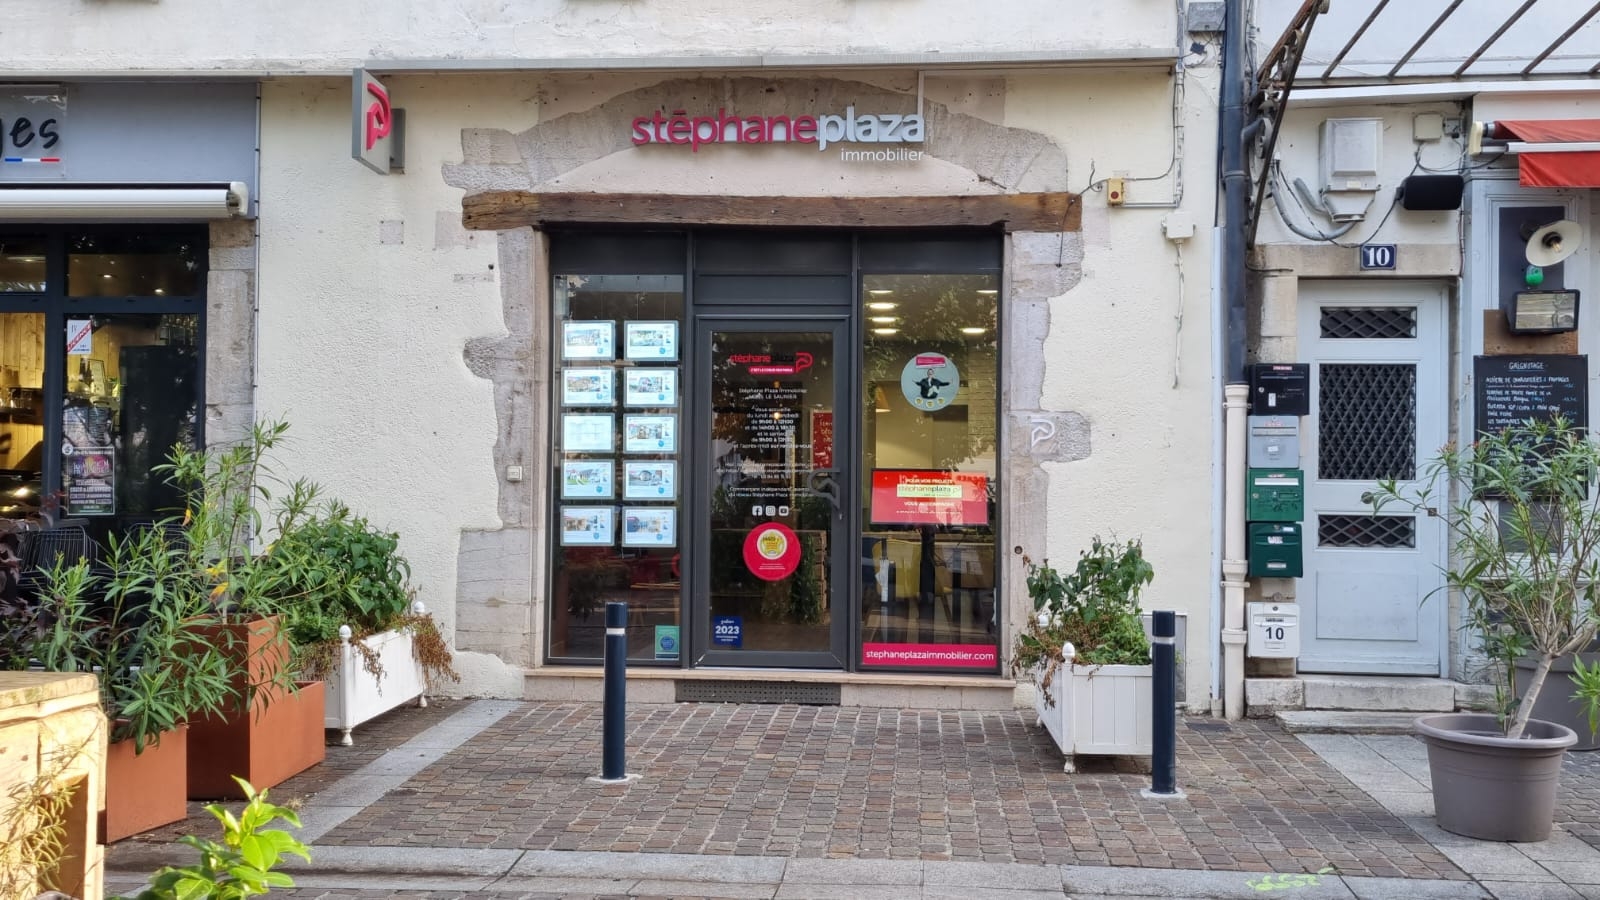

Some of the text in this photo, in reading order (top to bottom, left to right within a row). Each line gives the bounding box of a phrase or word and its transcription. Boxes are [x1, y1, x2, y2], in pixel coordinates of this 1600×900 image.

[0, 117, 60, 160] es
[840, 148, 925, 161] immobilier
[1367, 246, 1390, 266] 10
[715, 625, 740, 635] 2023
[1265, 627, 1284, 640] 10
[866, 650, 994, 661] stephaneplazaimmobilier.com
